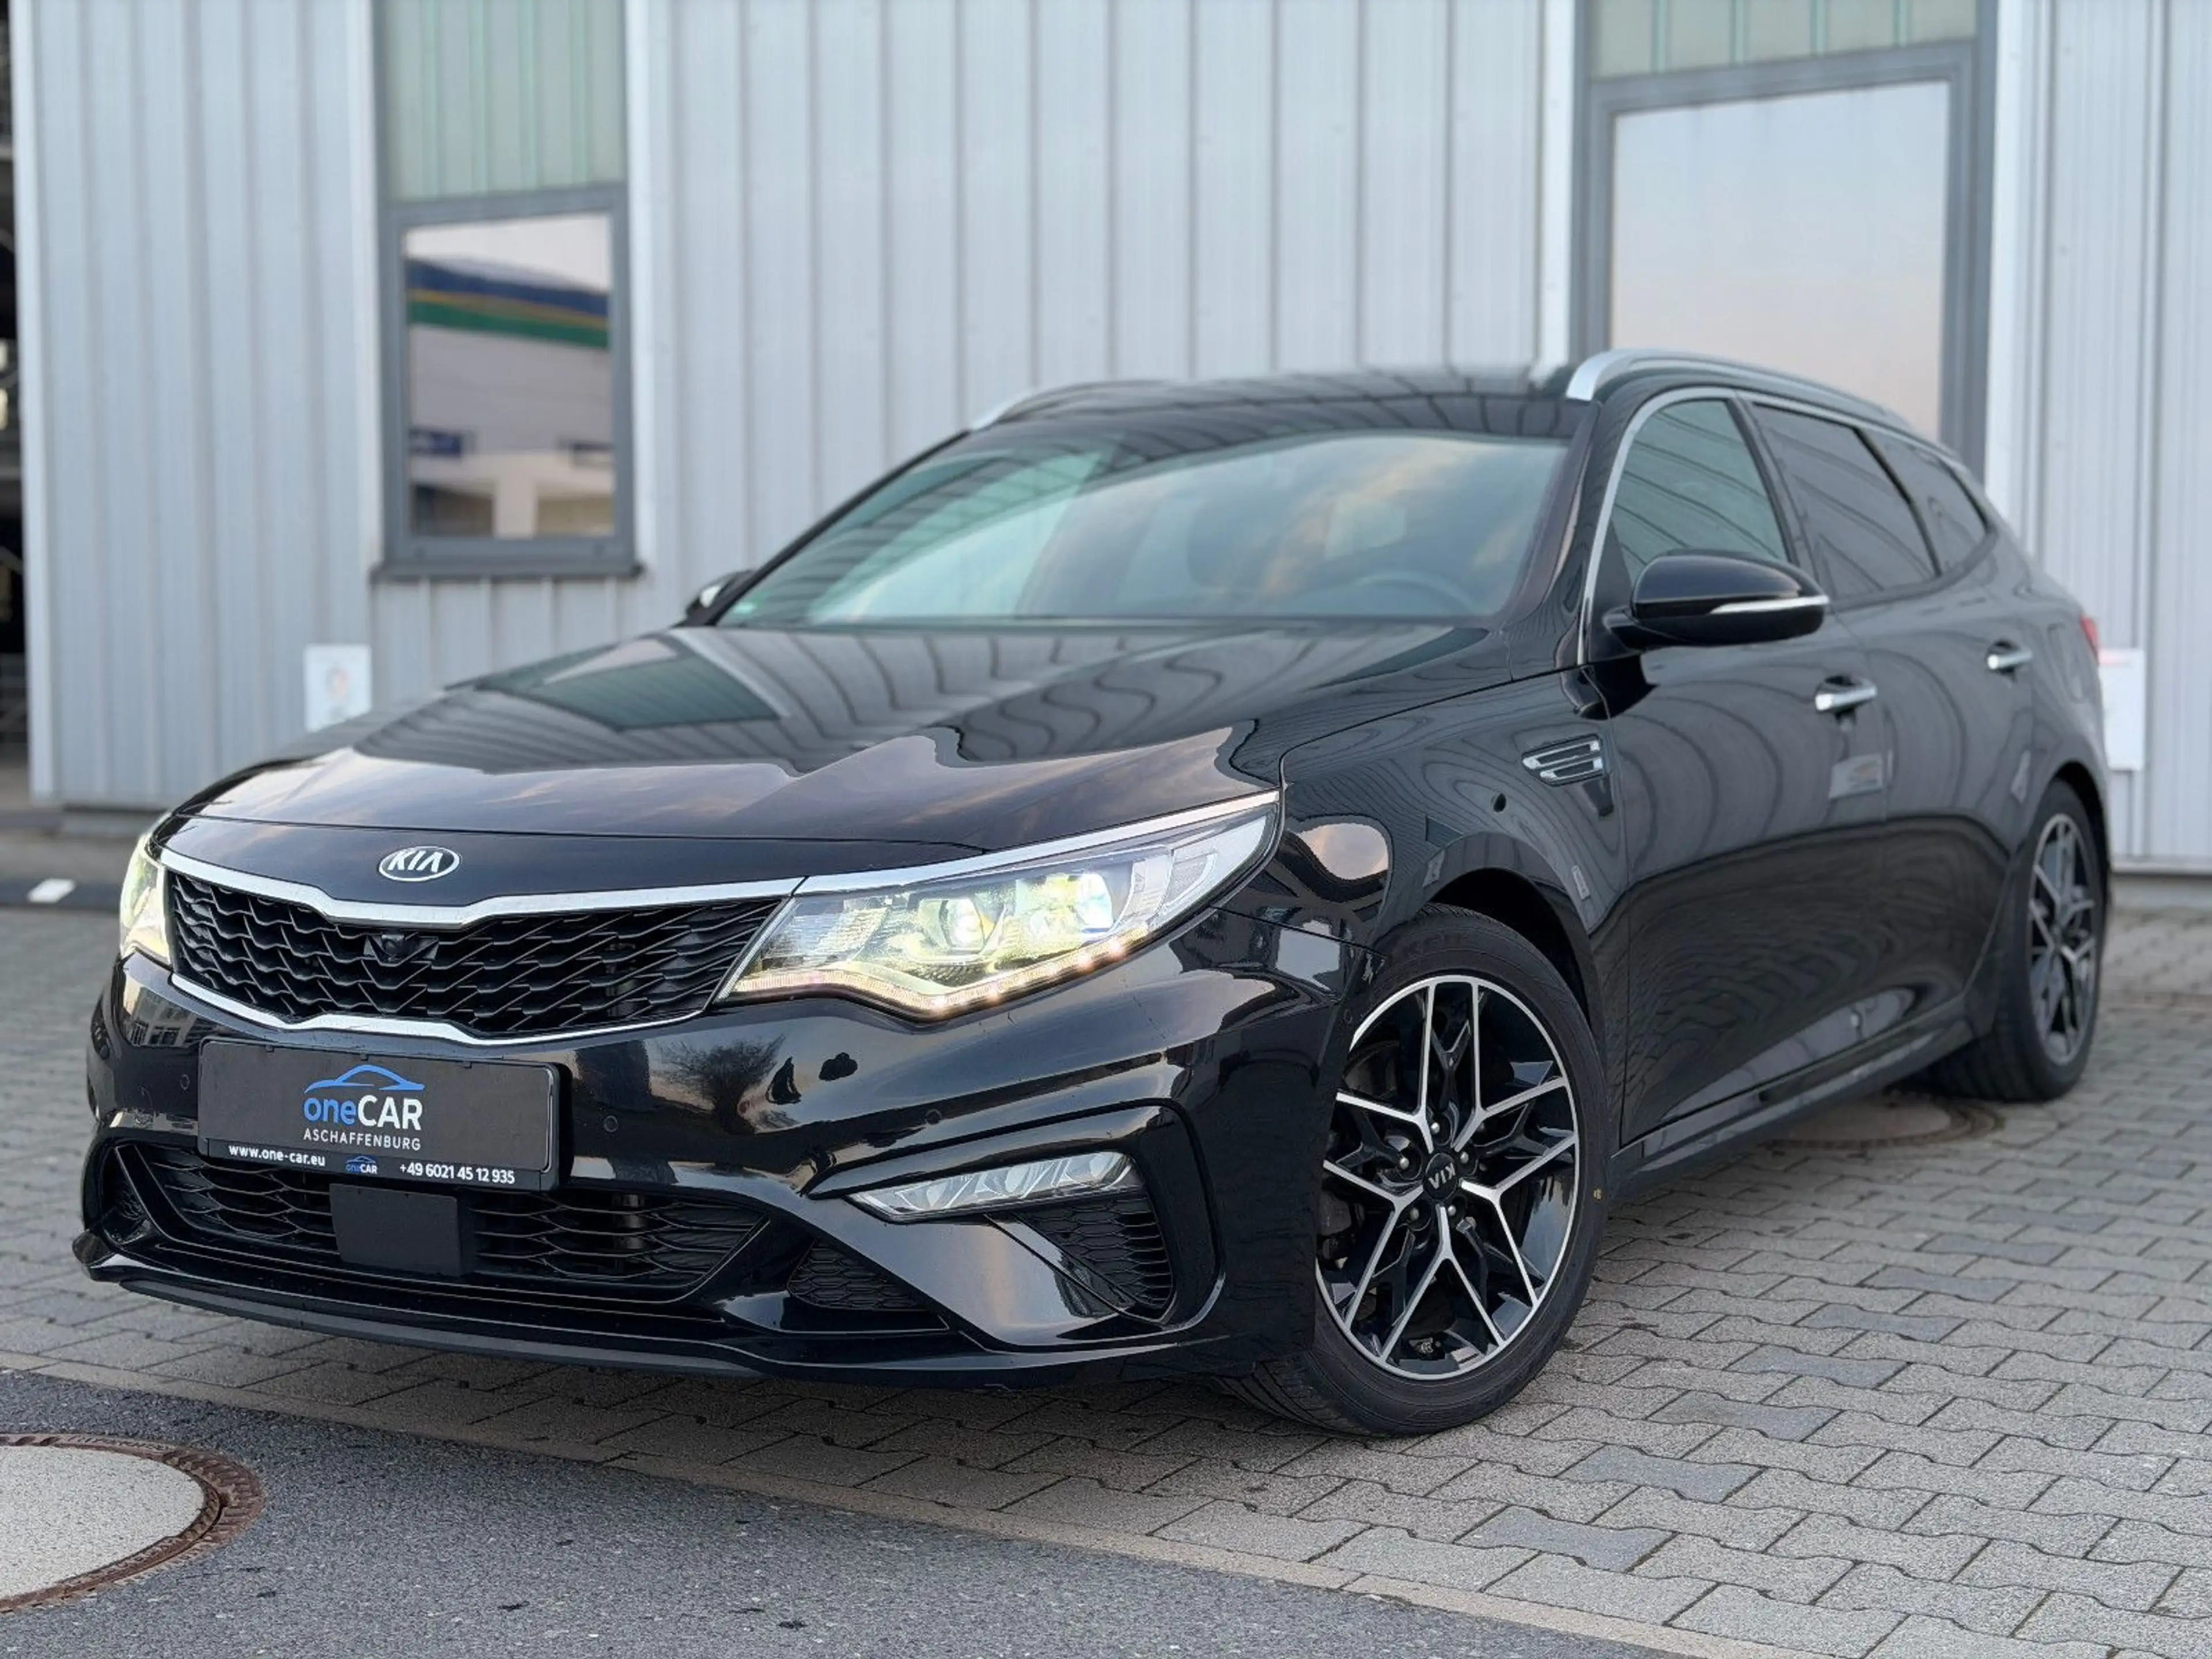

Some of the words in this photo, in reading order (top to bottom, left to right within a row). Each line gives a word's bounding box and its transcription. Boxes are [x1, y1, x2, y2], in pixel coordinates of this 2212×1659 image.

[387, 850, 443, 873] KIA
[304, 1094, 423, 1131] oneCAR
[303, 1127, 421, 1151] ASCHAFFENBURG
[228, 1145, 326, 1167] www.one-car.eu
[400, 1162, 423, 1176] +49
[425, 1164, 454, 1179] 6021
[457, 1166, 474, 1180] 45
[476, 1168, 490, 1183] 12
[492, 1169, 516, 1184] 935
[1428, 1162, 1456, 1190] KIA
